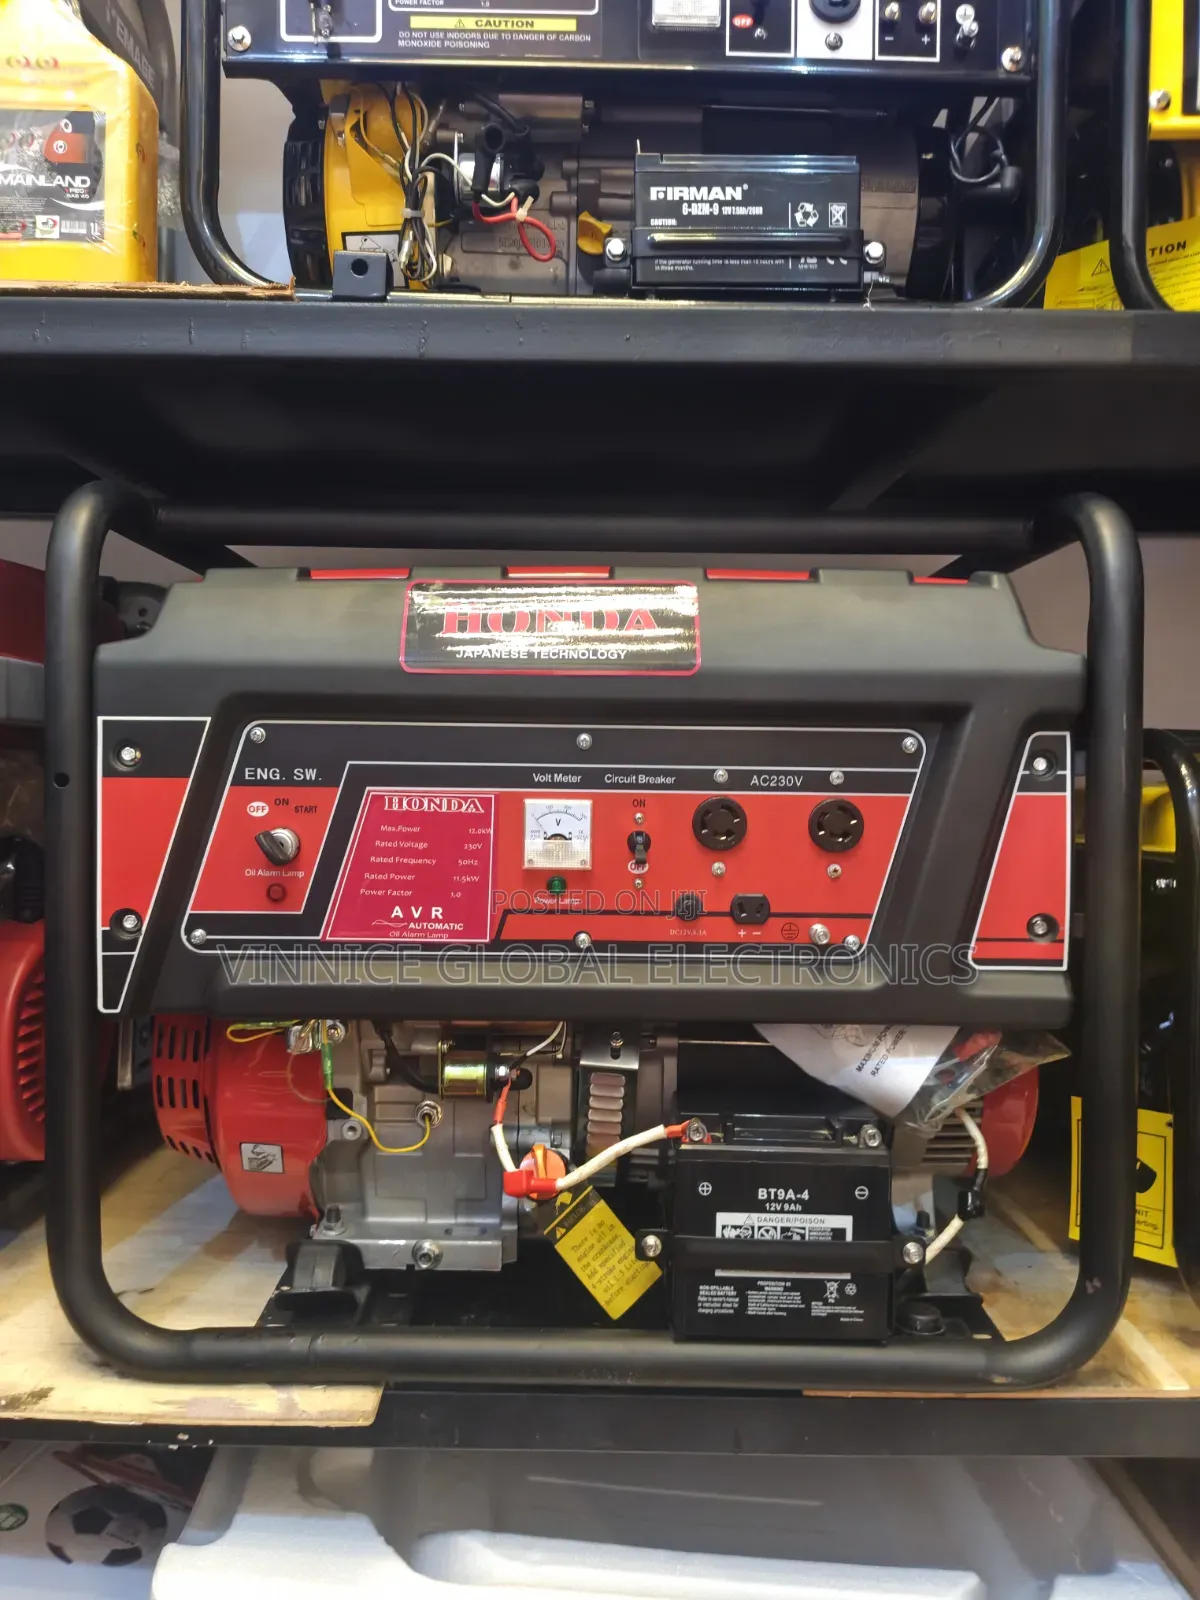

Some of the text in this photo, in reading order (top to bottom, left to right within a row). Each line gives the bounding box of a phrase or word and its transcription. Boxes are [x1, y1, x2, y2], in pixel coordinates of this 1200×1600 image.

[475, 19, 534, 28] CAUTION
[0, 174, 90, 188] MAINLAND
[682, 203, 719, 215] 6-DZM-9
[1149, 240, 1187, 258] TION
[438, 601, 660, 636] HONDA
[456, 650, 627, 660] JAPANESE TECHNOLOGY
[245, 767, 322, 781] ENG. SW.
[533, 773, 803, 787] Volt Meter Circuit Breaker AC230V
[274, 798, 289, 806] ON
[384, 796, 484, 813] HONDA
[632, 799, 646, 808] ON
[399, 841, 428, 849] Voltage
[396, 856, 436, 865] Frequency
[282, 870, 304, 878] Lamp
[408, 922, 464, 930] AUTOMATIC
[871, 1054, 888, 1077] RATED
[758, 1188, 809, 1200] BT9A-4
[765, 1202, 802, 1211] 12V 9Ah
